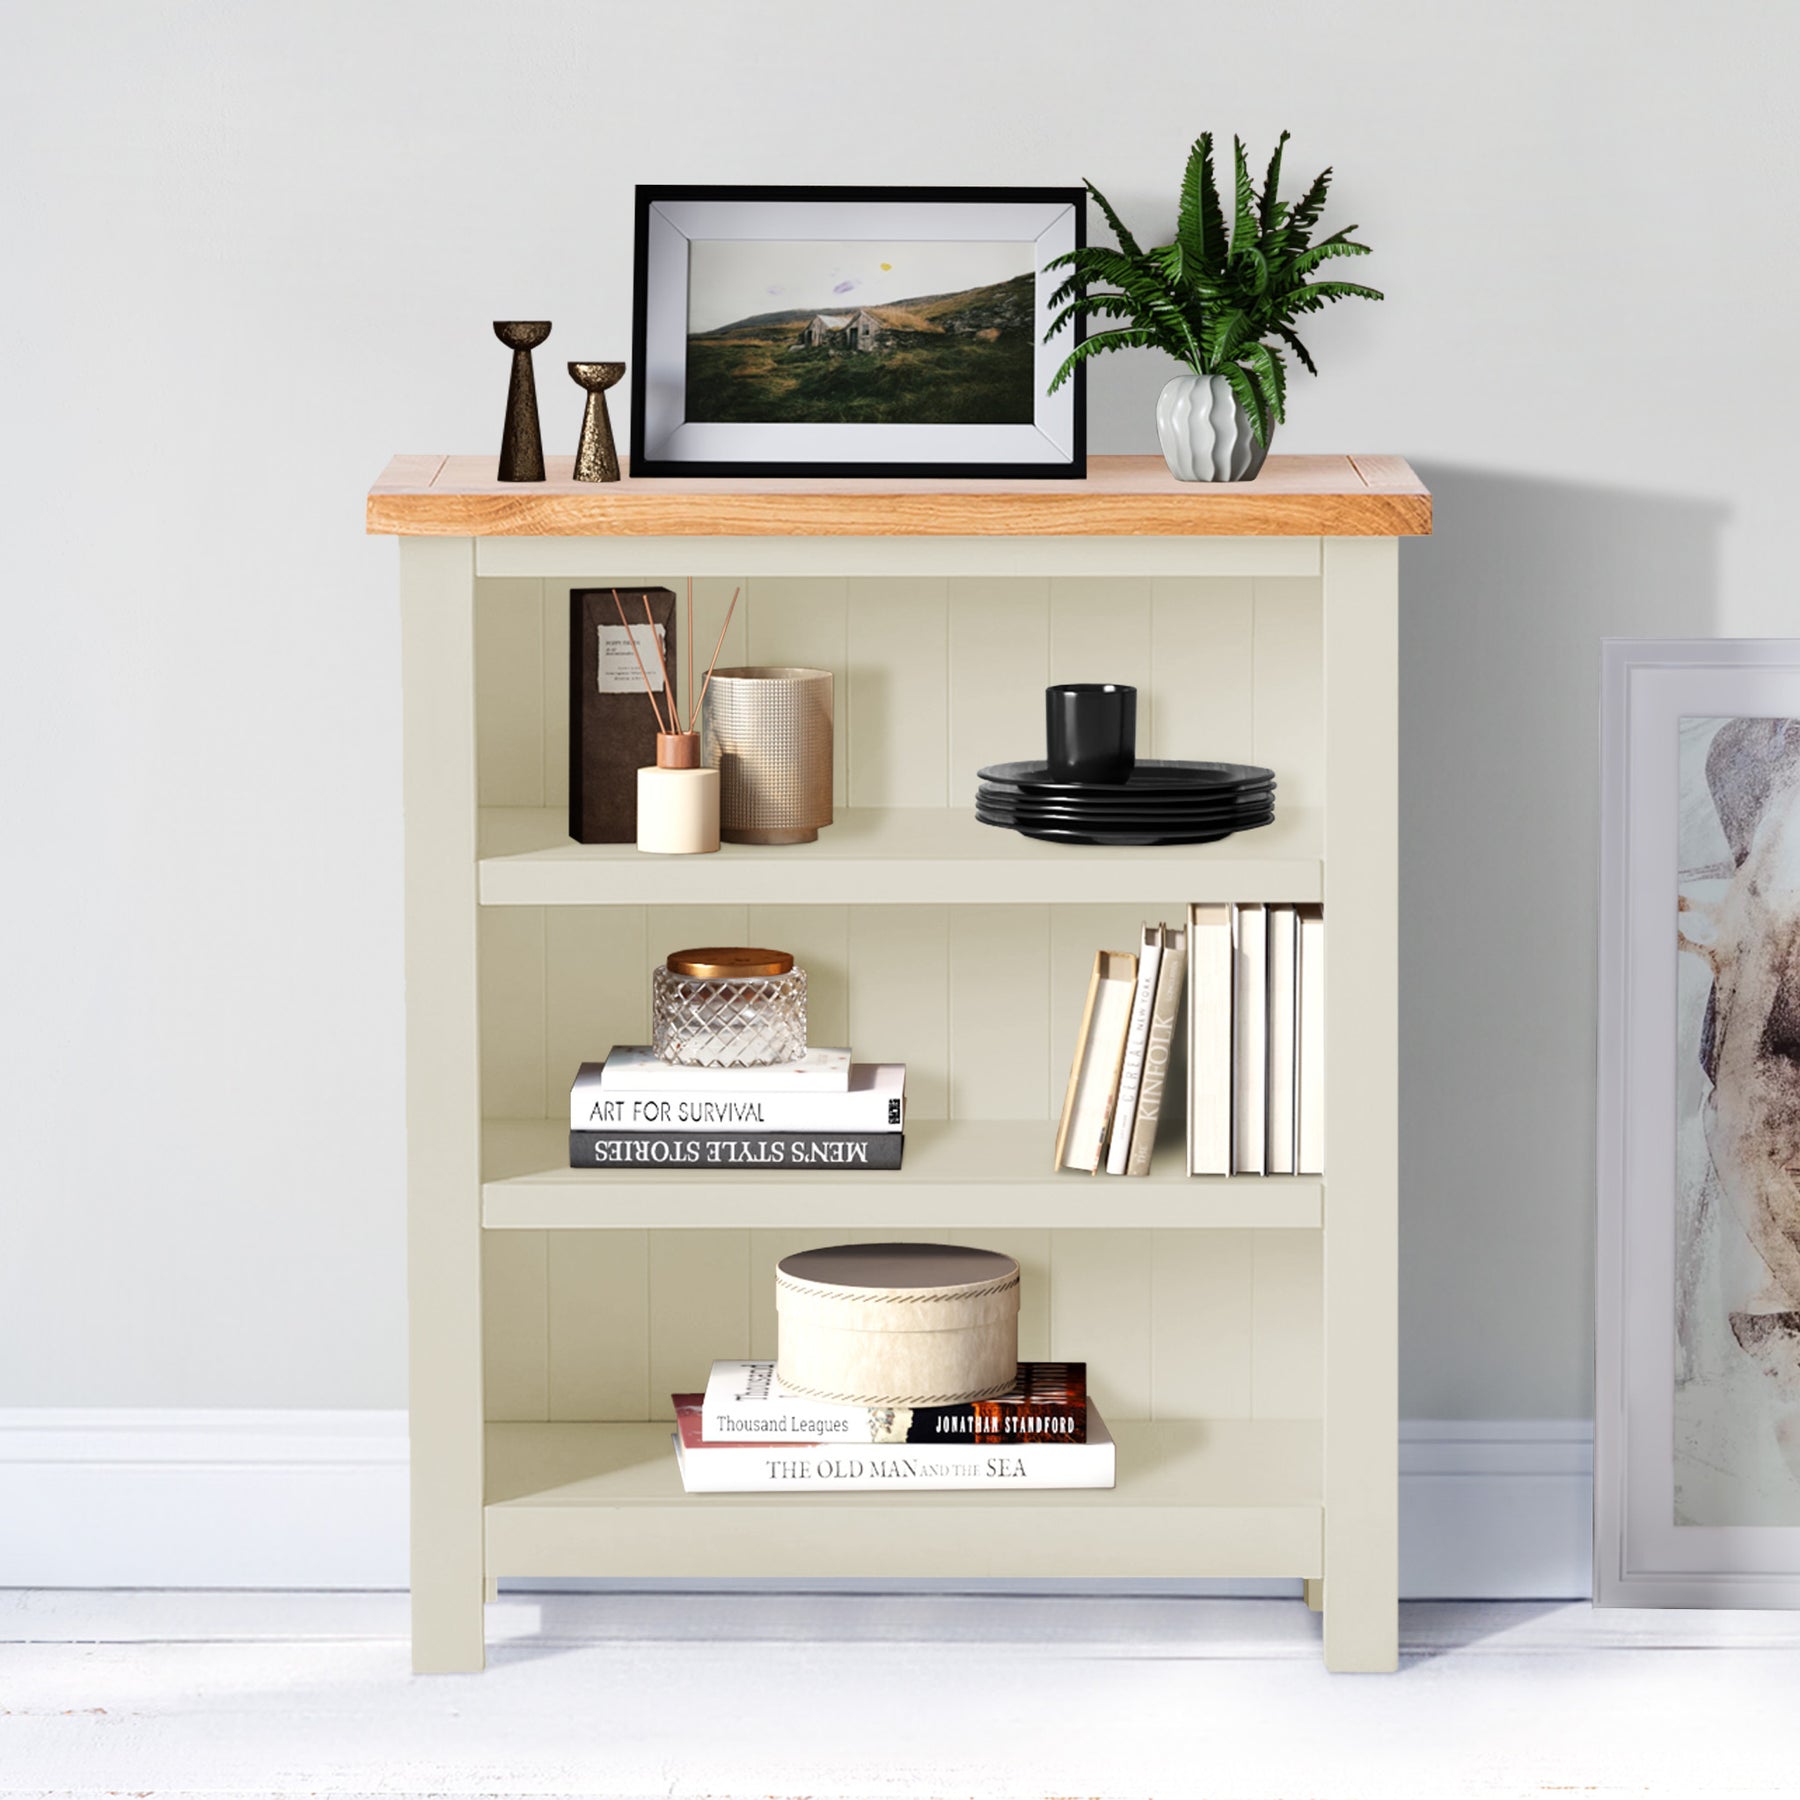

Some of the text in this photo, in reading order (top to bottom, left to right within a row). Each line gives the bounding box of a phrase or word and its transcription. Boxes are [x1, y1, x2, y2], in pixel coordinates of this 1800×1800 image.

[1141, 976, 1153, 1004] YORK
[1136, 1006, 1147, 1031] NEW
[1122, 1038, 1144, 1103] CEREAL
[1139, 1013, 1175, 1122] KINFOLK
[589, 1101, 765, 1122] ART FOR SURVIVAL
[594, 1140, 868, 1163] MEN'S STYLE STORIES
[734, 1362, 774, 1401] Thousand
[717, 1415, 849, 1437] Thousand Leagues
[935, 1415, 1075, 1434] JONATHAN STANDFORD
[766, 1457, 1027, 1479] THE OLD MAN AND THE SEA
